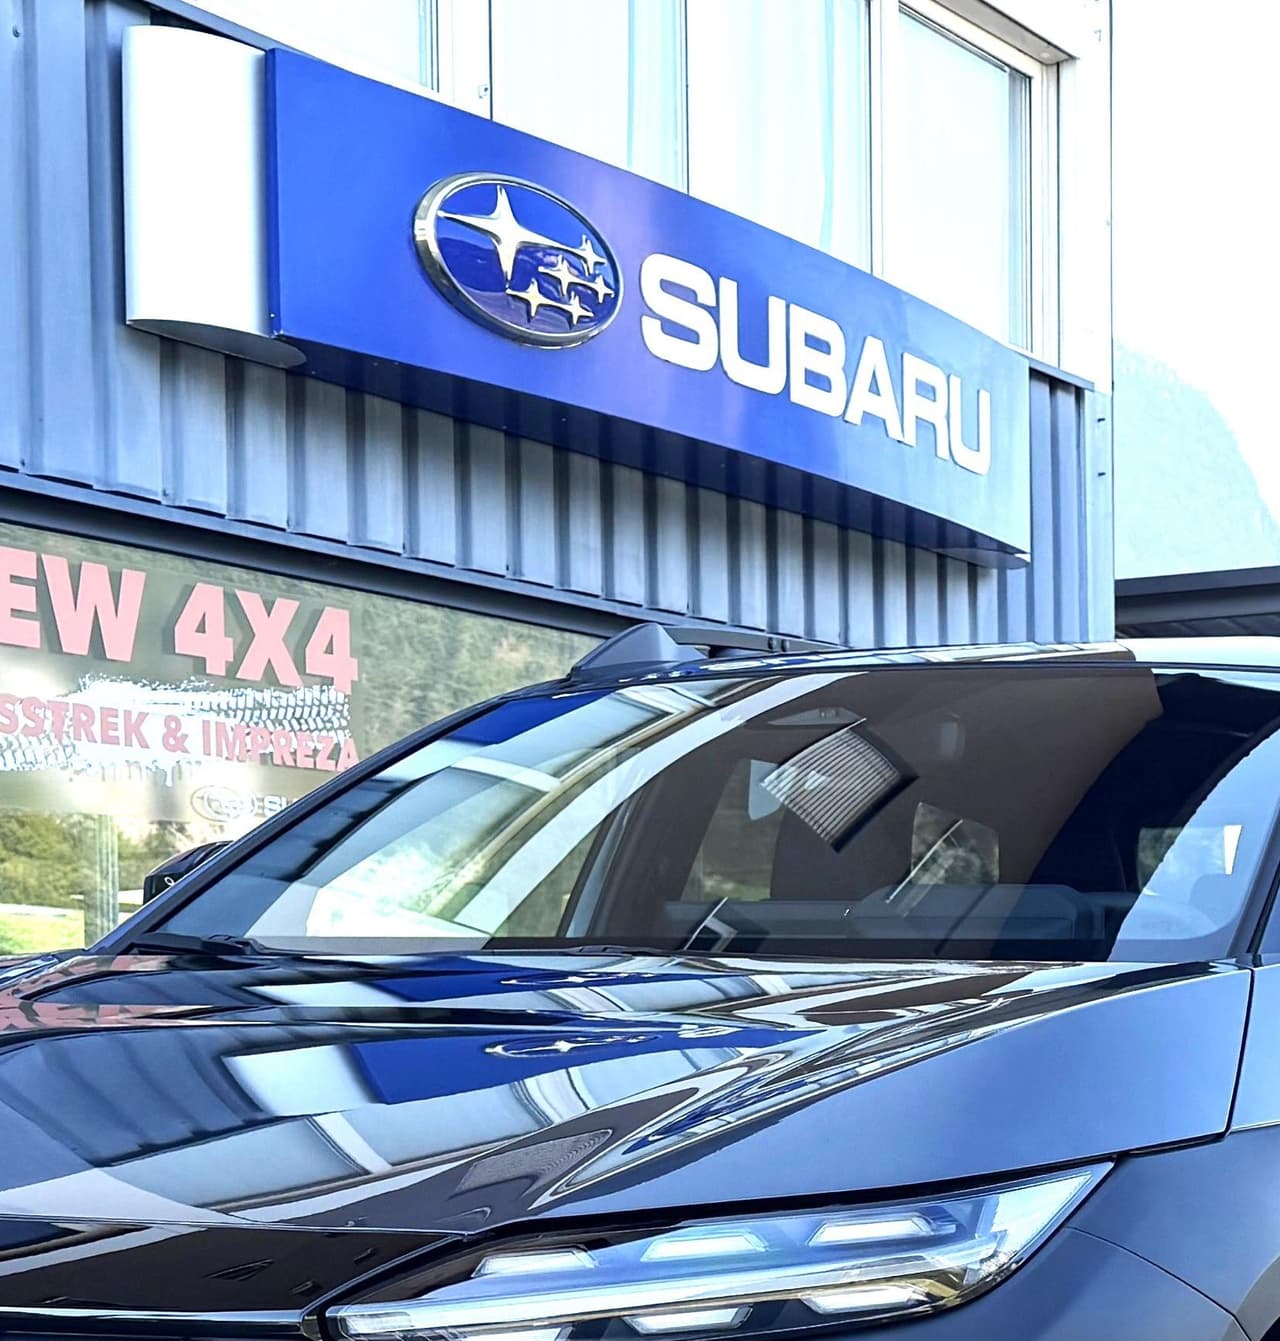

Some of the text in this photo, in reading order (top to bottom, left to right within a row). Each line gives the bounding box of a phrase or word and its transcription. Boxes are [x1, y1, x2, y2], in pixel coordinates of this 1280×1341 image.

[640, 252, 992, 475] SUBARU
[174, 582, 359, 696] 4X4
[161, 715, 190, 754] &
[202, 725, 360, 772] IMPREZA
